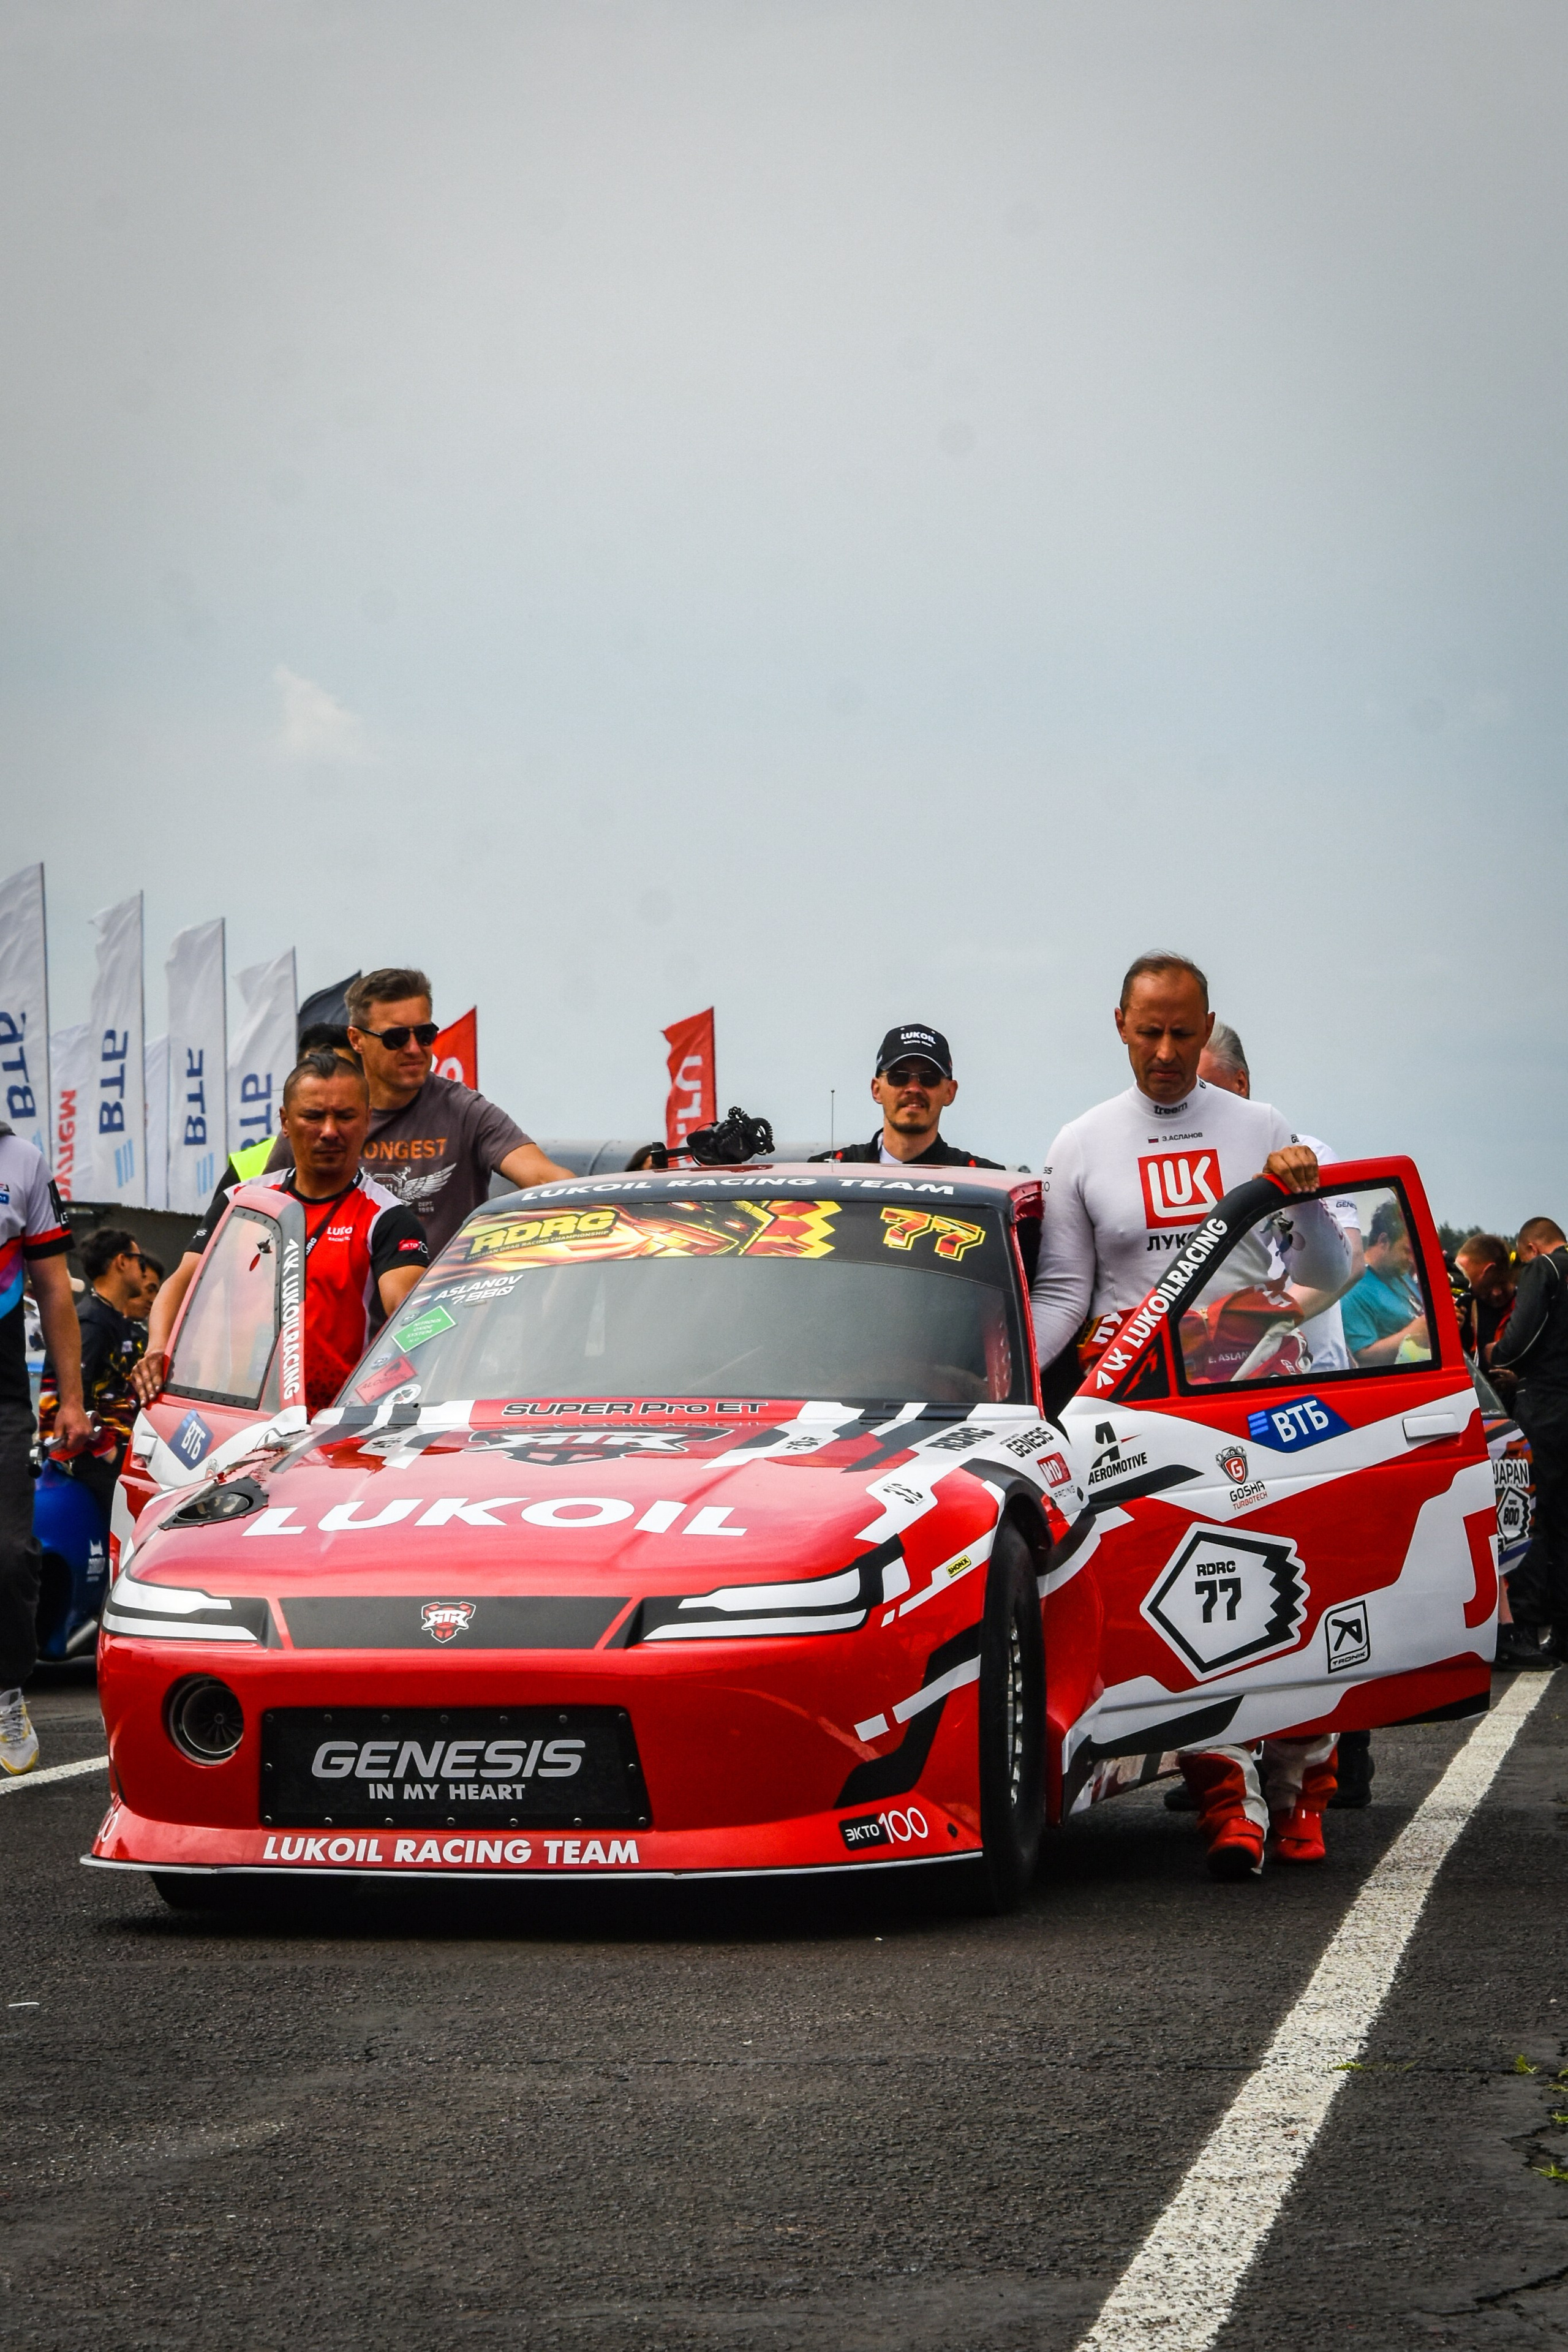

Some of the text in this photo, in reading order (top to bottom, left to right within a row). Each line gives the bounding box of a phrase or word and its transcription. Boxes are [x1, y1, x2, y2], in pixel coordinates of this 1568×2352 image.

[900, 1031, 937, 1044] LUKOIL
[363, 1137, 448, 1160] ONGEST
[521, 1178, 954, 1201] LUKOIL RACING TEAM
[469, 1210, 616, 1255] RDRC
[500, 1243, 521, 1253] DRAG
[521, 1237, 549, 1248] RACING
[550, 1230, 609, 1242] CHAMPIONSHIP
[881, 1207, 986, 1262] 77
[434, 1275, 523, 1302] ASLANOV
[1121, 1218, 1227, 1349] LUKOILRACING
[282, 1273, 300, 1400] LUKOILRACING
[1218, 1351, 1252, 1362] ASLAN
[502, 1402, 768, 1416] SUPER Pro ET
[1271, 1400, 1329, 1443] ВТБ
[181, 1420, 206, 1460] ВТБ
[1006, 1426, 1055, 1458] GENESIS
[1088, 1452, 1148, 1485] AEROMOTIVE
[1230, 1480, 1266, 1502] GOSHA
[1232, 1491, 1268, 1511] TURBOTECH
[241, 1496, 749, 1537] LUKOIL
[1502, 1507, 1520, 1526] 800
[1196, 1560, 1236, 1577] RDRC
[1194, 1577, 1242, 1624] 77
[1332, 1651, 1366, 1666] TRONIK
[311, 1739, 586, 1779] GENESIS
[369, 1784, 526, 1800] IN MY HEART
[845, 1806, 929, 1844] ЭКТО 100
[263, 1836, 640, 1864] LUKOIL RACING TEAM
